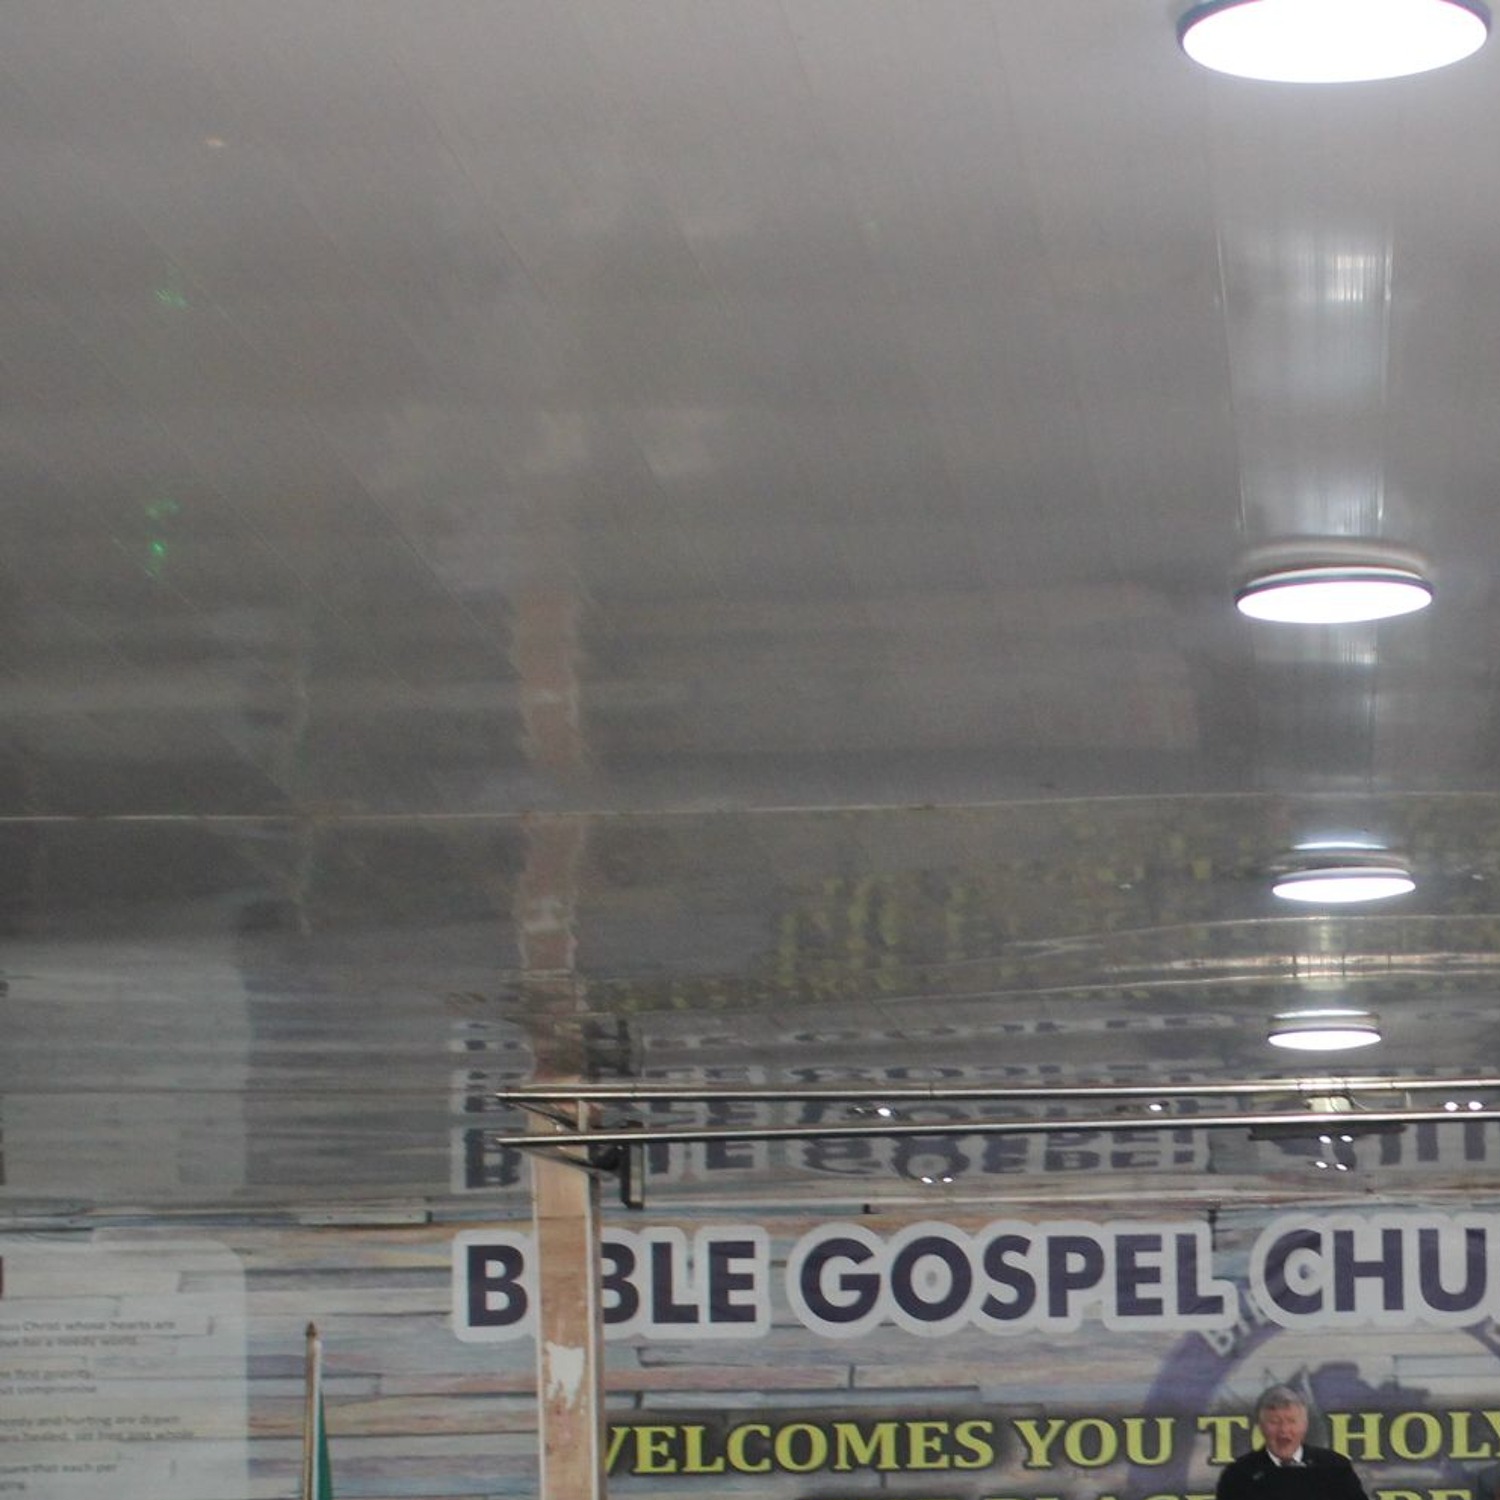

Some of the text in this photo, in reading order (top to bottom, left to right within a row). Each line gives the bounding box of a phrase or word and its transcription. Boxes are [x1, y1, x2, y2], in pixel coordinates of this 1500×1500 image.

[467, 1240, 757, 1328] BBLE
[800, 1232, 1224, 1324] GOSPEL
[1017, 1417, 1176, 1470] YOU
[1198, 1413, 1265, 1464] T
